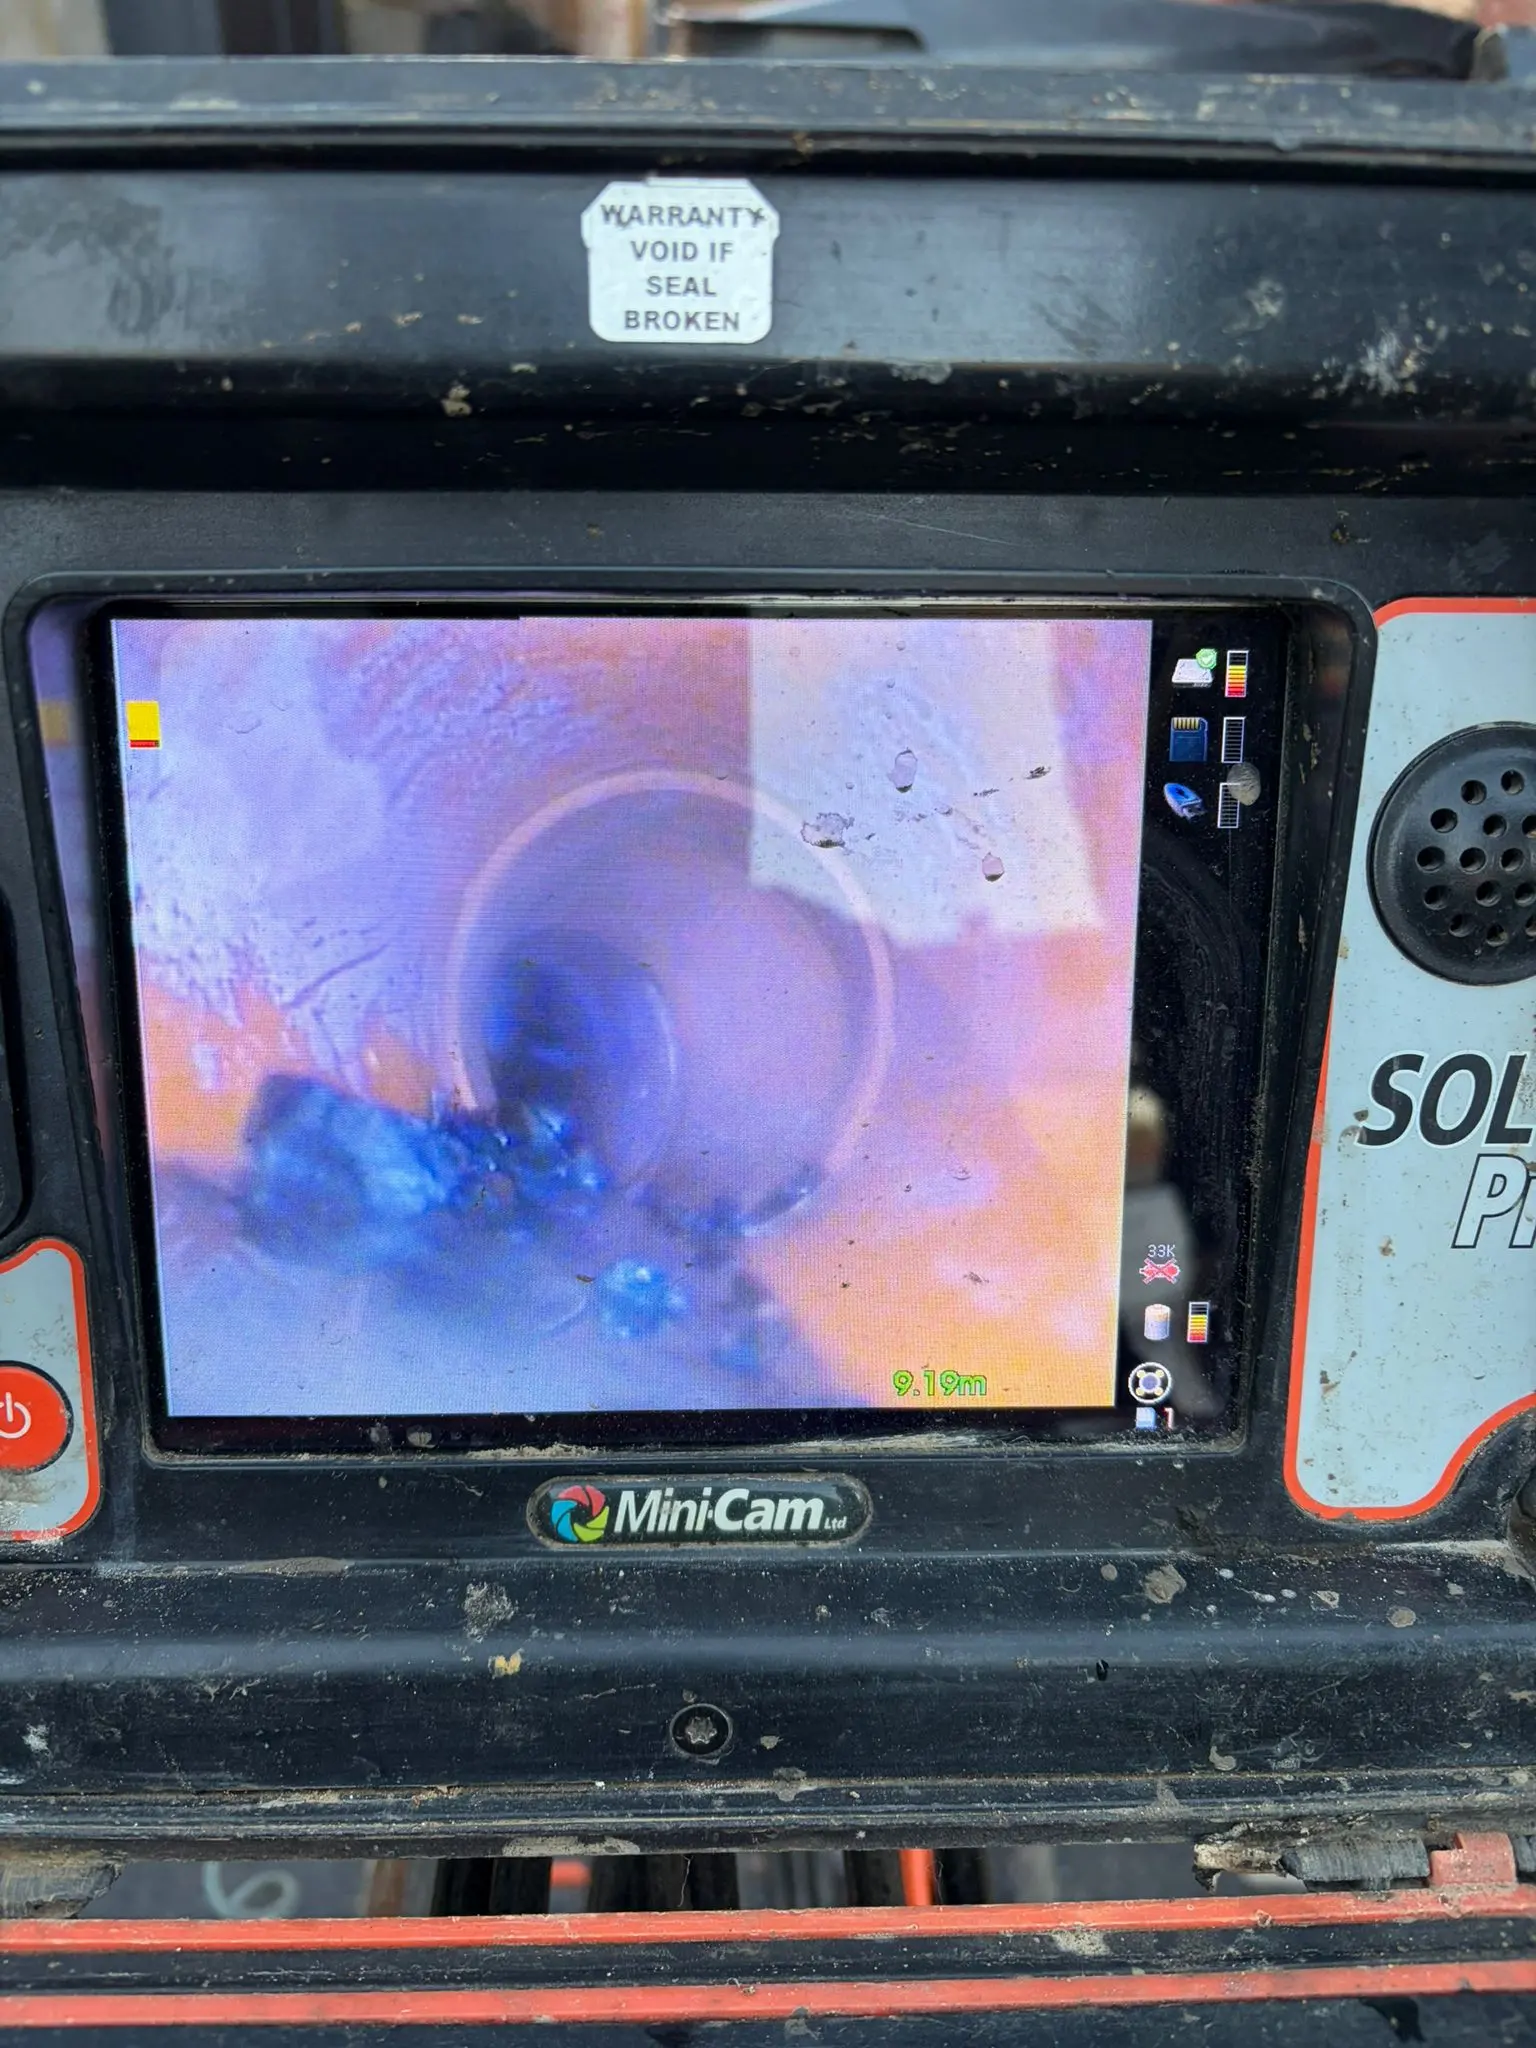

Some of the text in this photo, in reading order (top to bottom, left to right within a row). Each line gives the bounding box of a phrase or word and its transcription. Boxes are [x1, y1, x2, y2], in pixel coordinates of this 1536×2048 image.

[600, 204, 767, 230] WARRANTY
[630, 240, 734, 263] VOID IF
[645, 275, 718, 298] SEAL
[623, 310, 741, 332] BROKEN
[1354, 1051, 1535, 1148] SOL
[1147, 1243, 1176, 1258] 33K
[892, 1369, 988, 1396] 9.19m
[824, 1515, 848, 1531] Ltd
